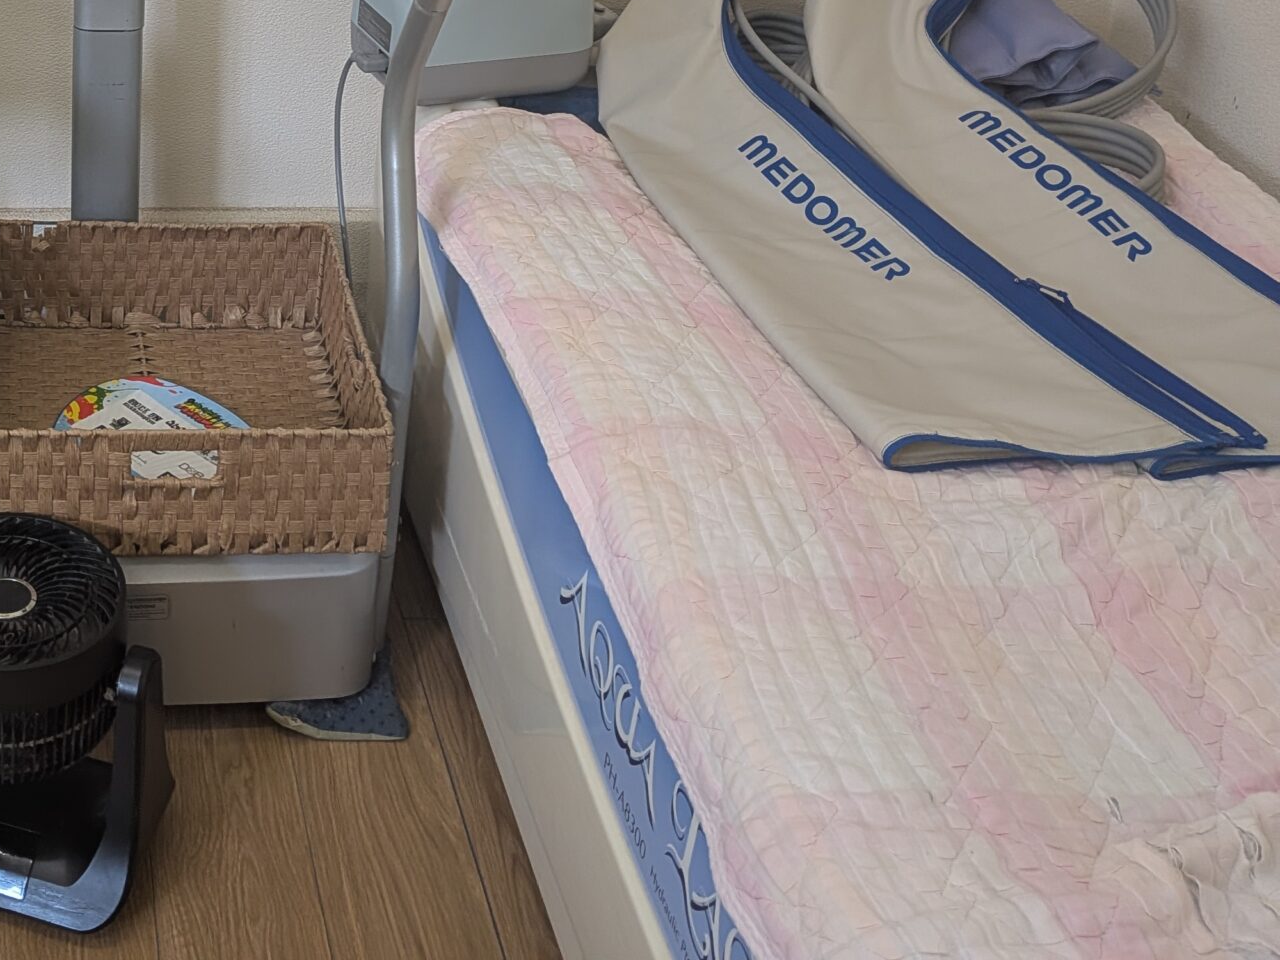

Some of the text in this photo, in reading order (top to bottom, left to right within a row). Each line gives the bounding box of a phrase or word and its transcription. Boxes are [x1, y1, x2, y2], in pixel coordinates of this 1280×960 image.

[738, 134, 911, 281] MEDOMER
[958, 110, 1153, 262] MEDOMER
[560, 569, 657, 833] AQUA
[603, 751, 647, 860] PH-A8300
[649, 864, 680, 938] Hydraulic
